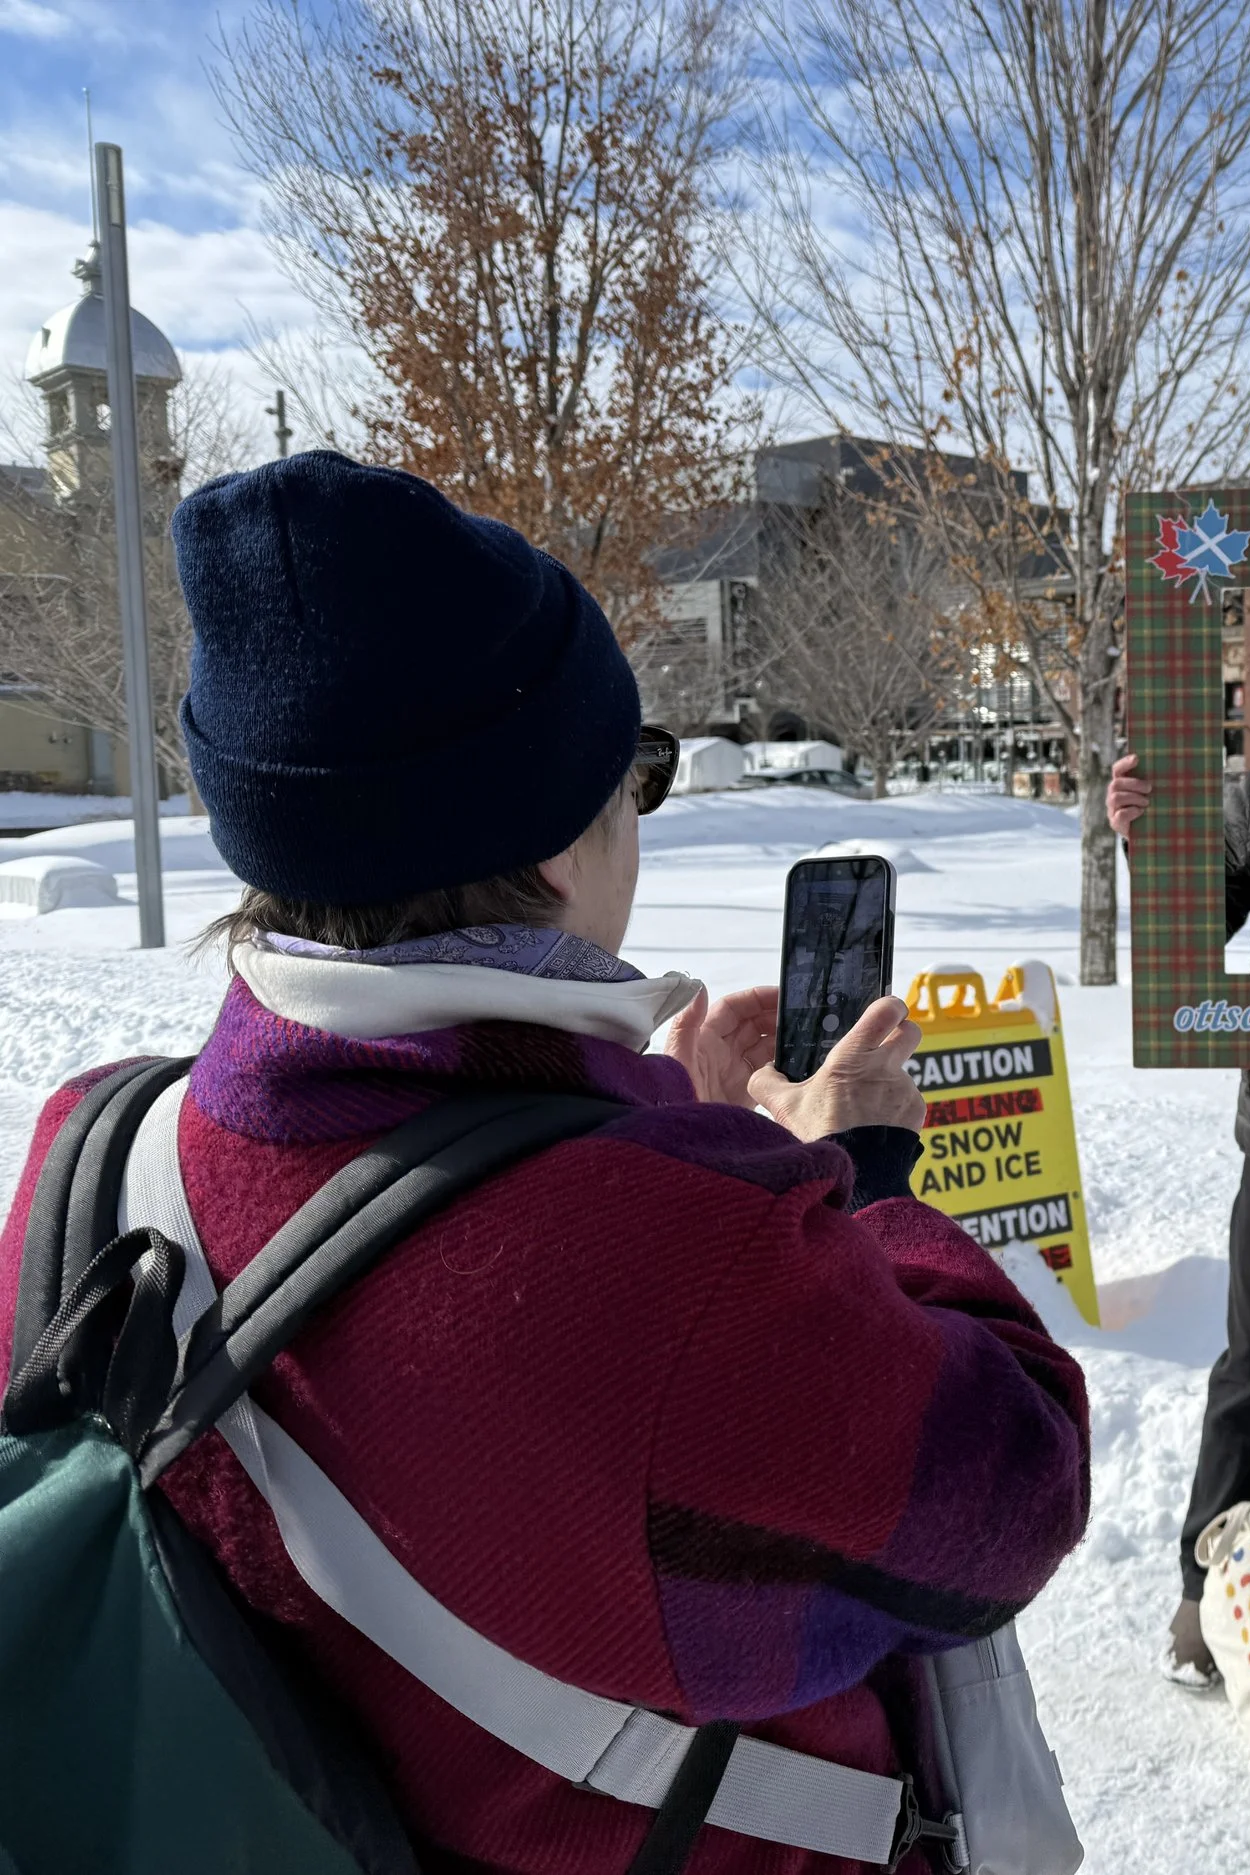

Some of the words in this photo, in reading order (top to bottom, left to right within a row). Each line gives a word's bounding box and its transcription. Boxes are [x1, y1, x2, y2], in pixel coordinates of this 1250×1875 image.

[902, 1045, 1035, 1088] CAUTION
[921, 1089, 1039, 1127] ALLING
[930, 1121, 1022, 1160] SNOW
[920, 1160, 986, 1196] AND
[996, 1151, 1042, 1183] ICE
[957, 1200, 1069, 1245] ENTION
